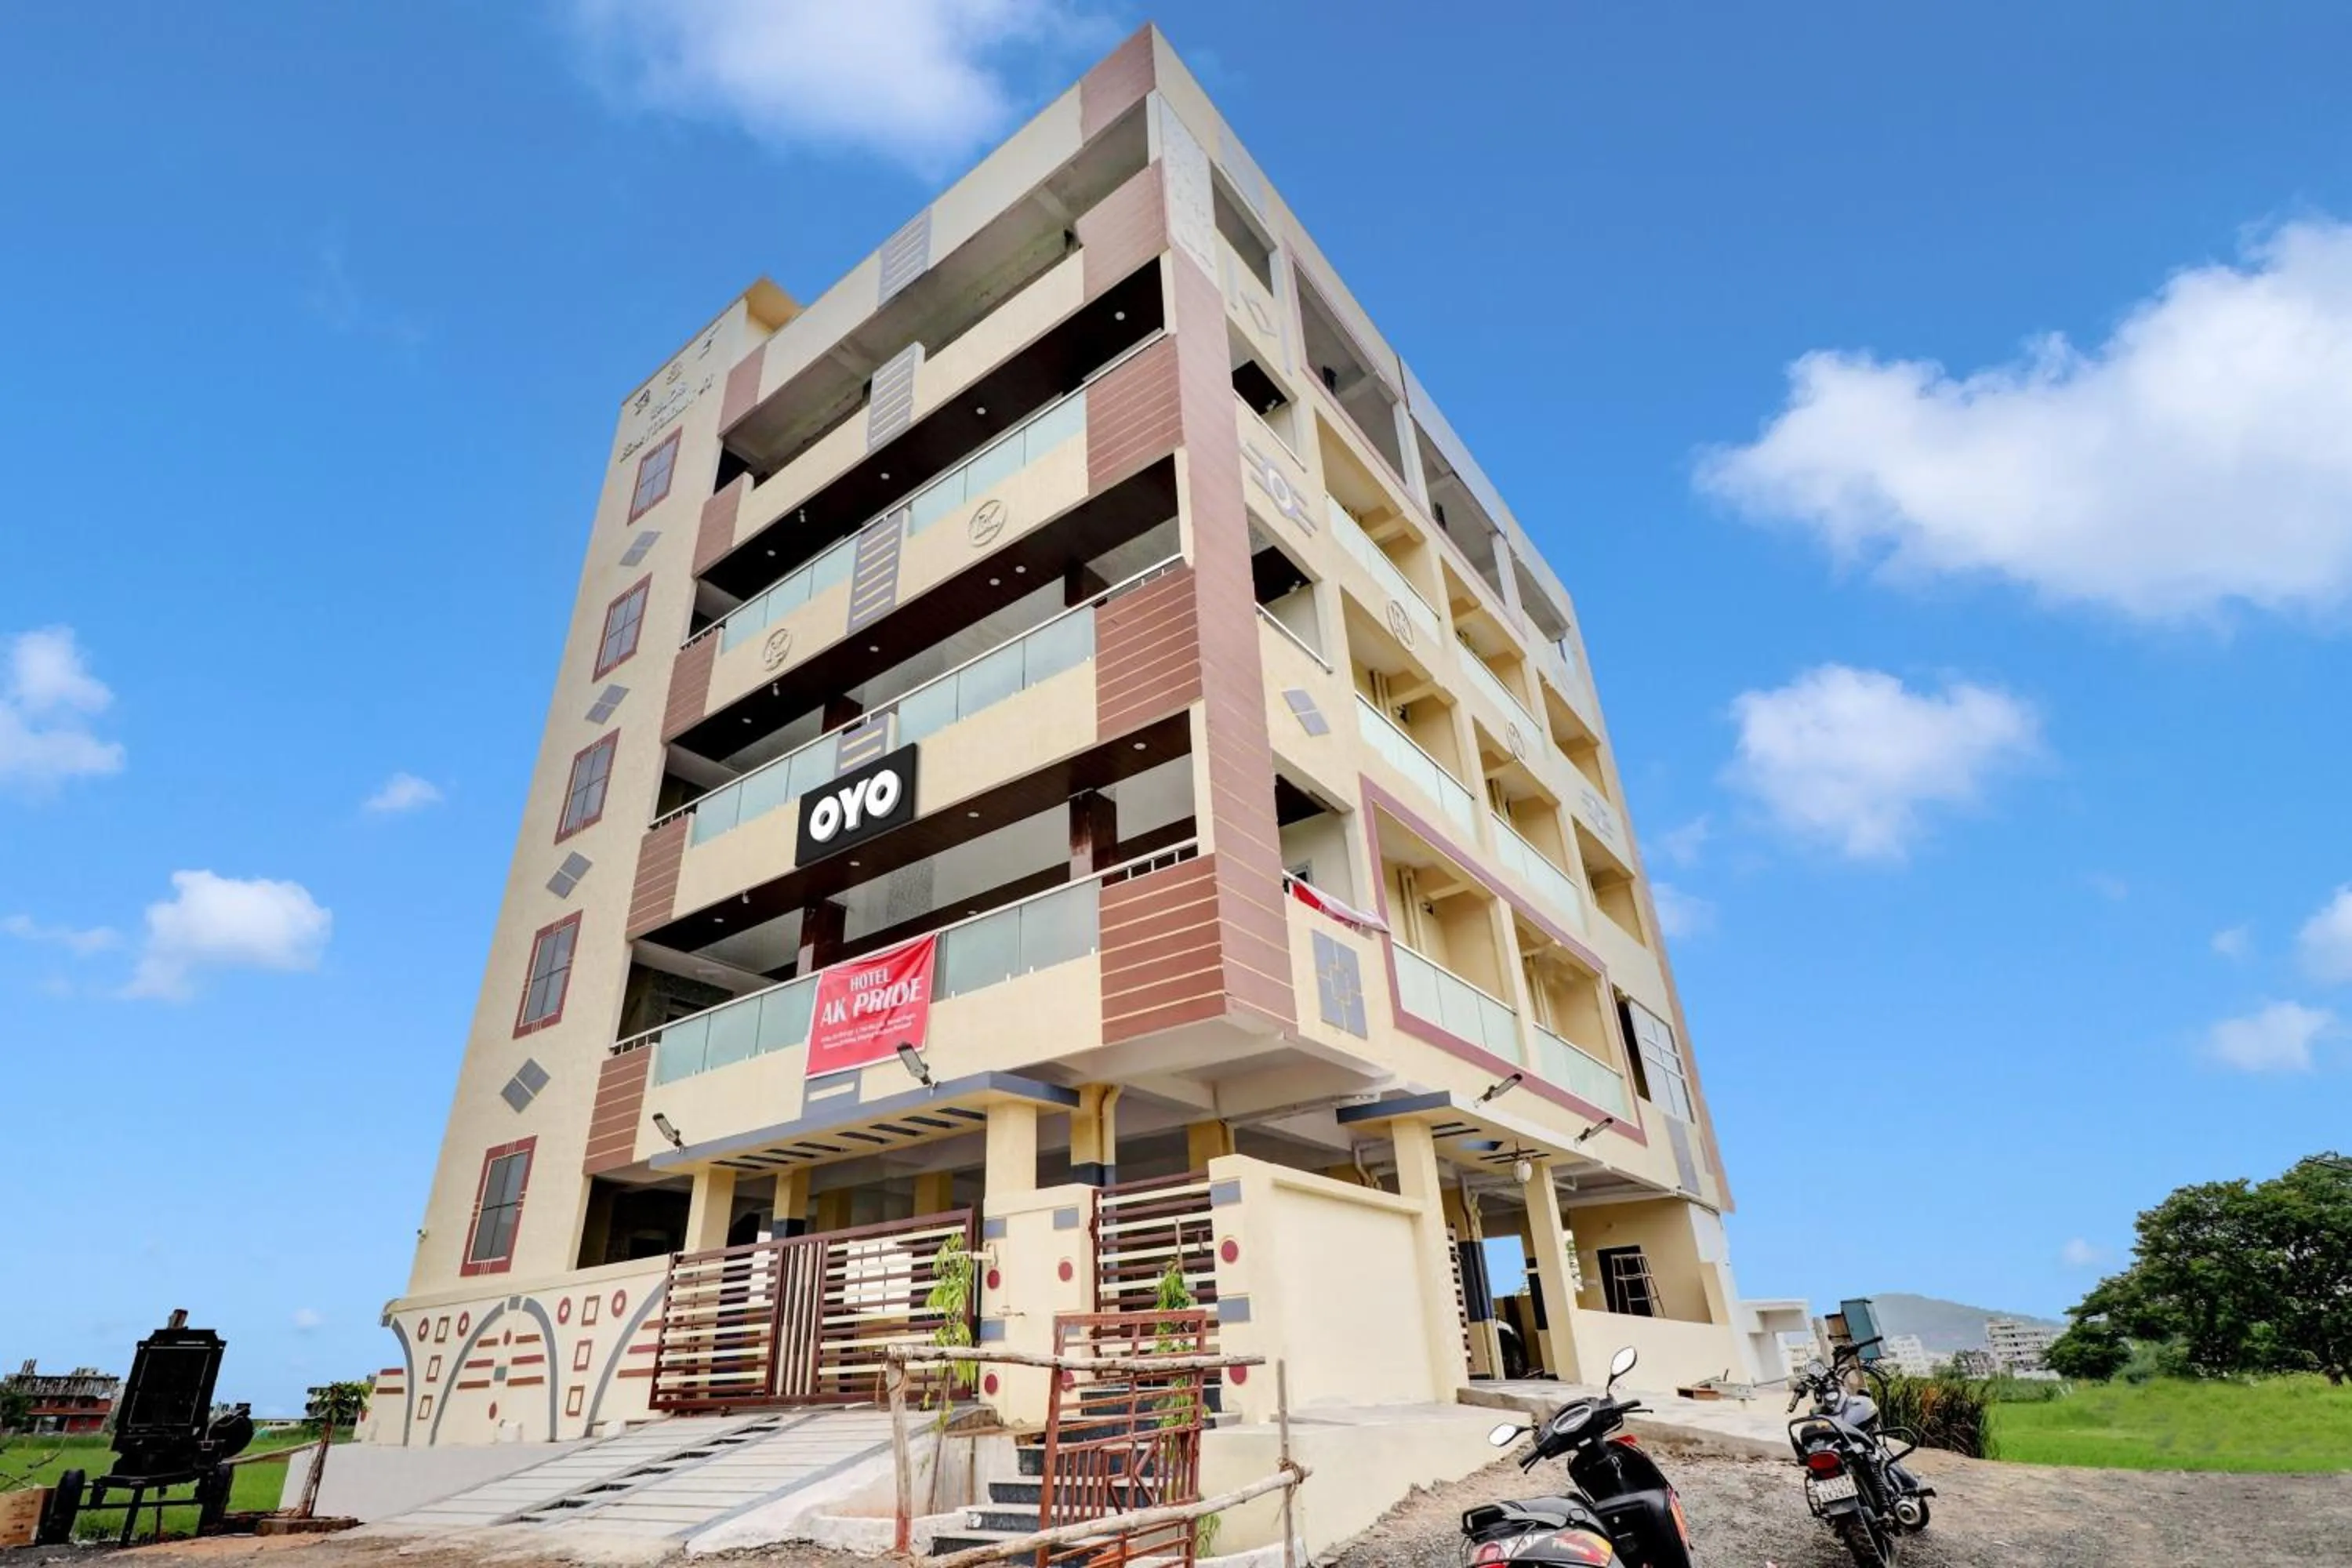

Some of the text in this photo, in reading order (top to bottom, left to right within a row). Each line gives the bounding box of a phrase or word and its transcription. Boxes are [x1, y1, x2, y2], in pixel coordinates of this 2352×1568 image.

[809, 769, 902, 843] OYO
[820, 976, 924, 1027] AK PRIDE
[850, 967, 891, 992] HOTEL
